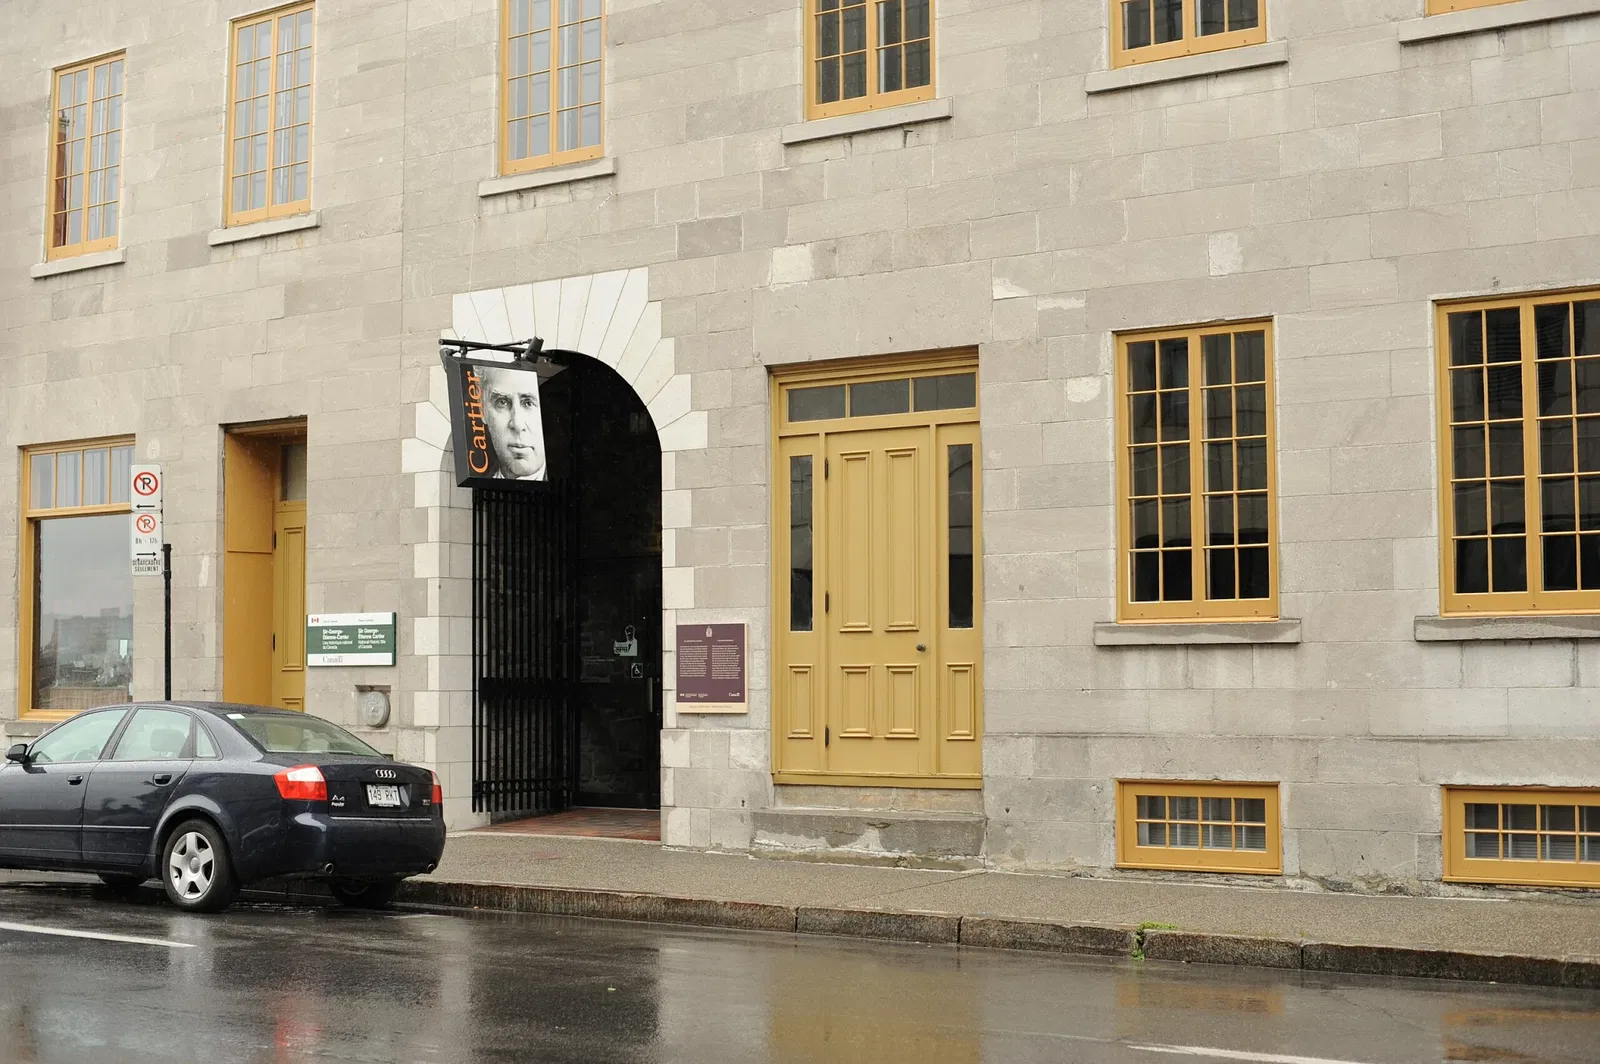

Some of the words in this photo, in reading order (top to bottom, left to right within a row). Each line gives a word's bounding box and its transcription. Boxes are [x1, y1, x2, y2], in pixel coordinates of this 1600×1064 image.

[465, 370, 488, 473] Cartier
[142, 478, 151, 490] P
[144, 518, 150, 528] P
